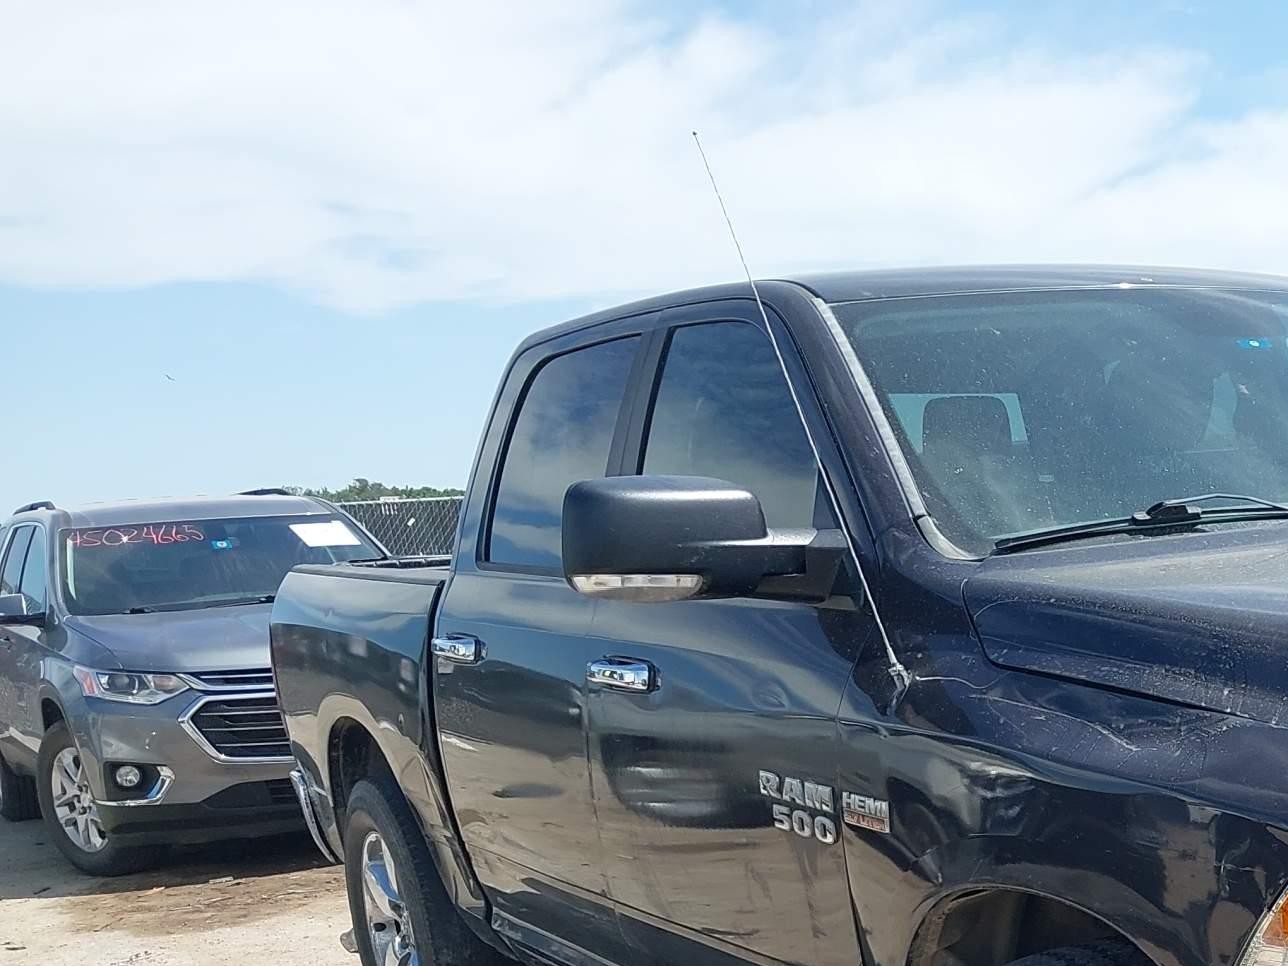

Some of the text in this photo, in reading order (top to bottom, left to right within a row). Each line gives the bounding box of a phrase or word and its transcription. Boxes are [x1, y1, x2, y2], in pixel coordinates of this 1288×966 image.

[69, 524, 205, 548] 45024665
[759, 769, 835, 814] RAM
[841, 791, 890, 819] HEMI
[772, 803, 837, 845] 500
